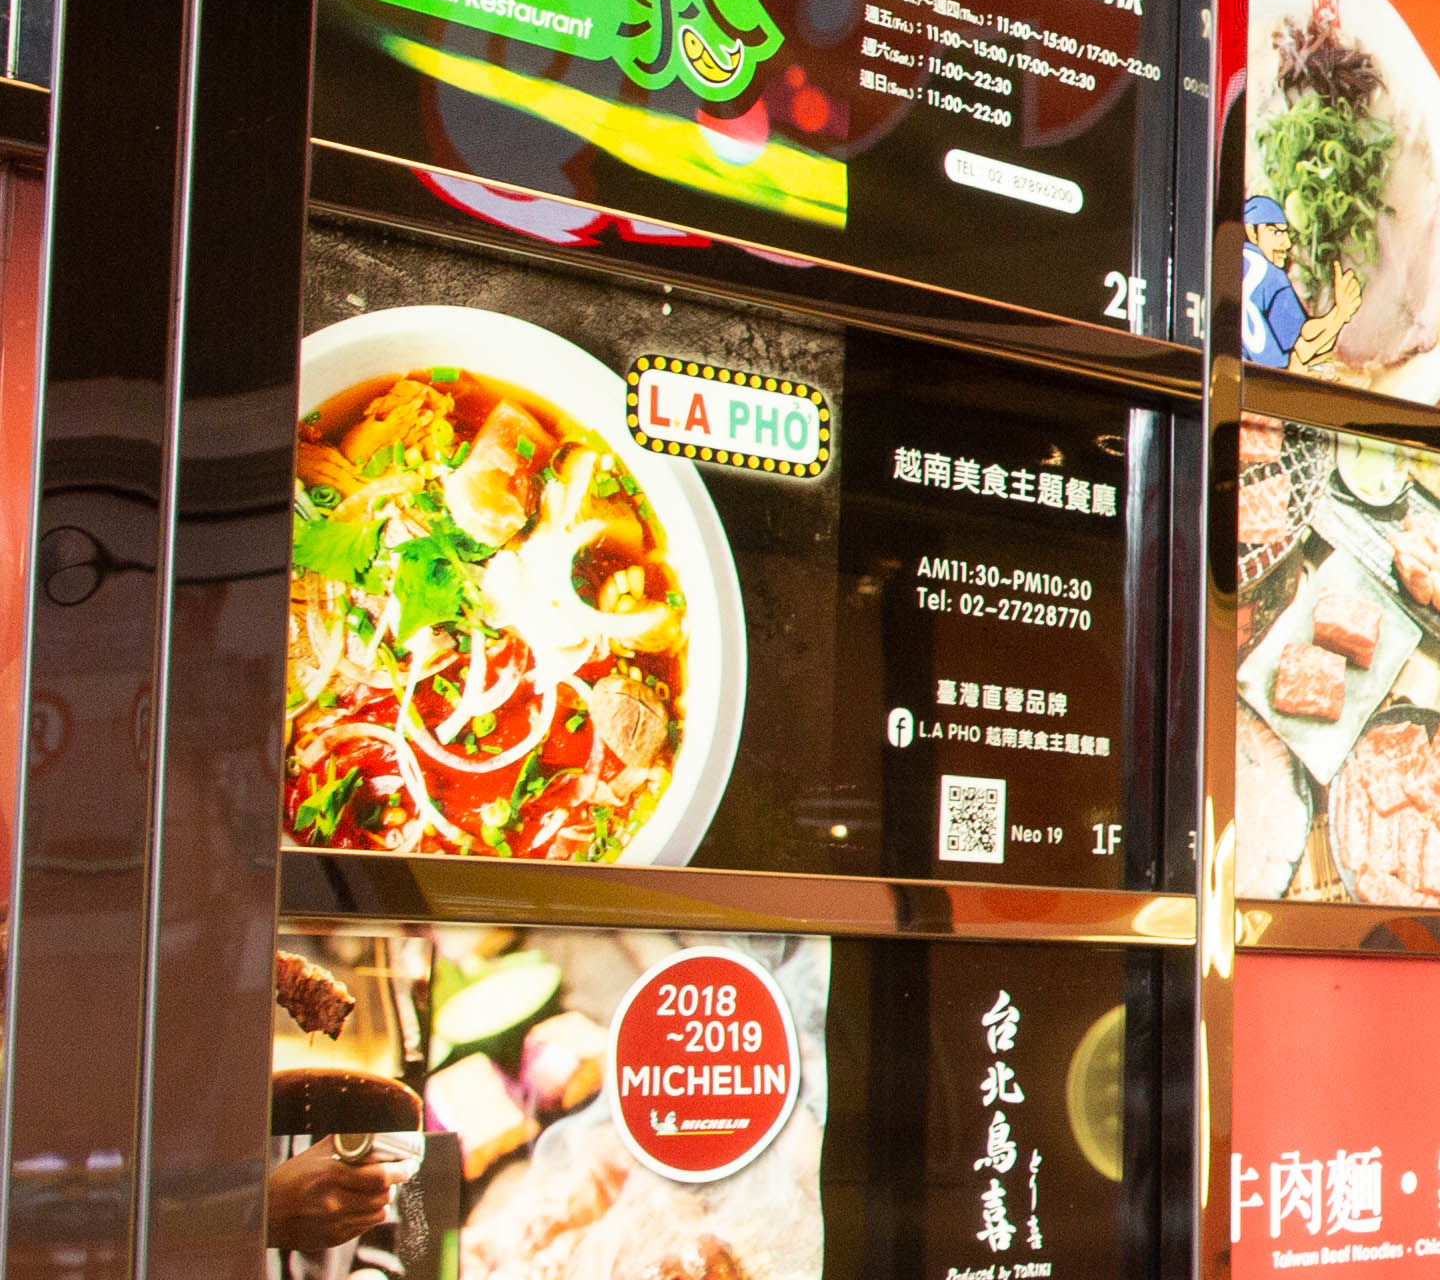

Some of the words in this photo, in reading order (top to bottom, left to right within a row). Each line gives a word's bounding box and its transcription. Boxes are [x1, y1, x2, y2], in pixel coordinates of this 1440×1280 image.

[1104, 272, 1147, 323] 2F
[650, 385, 711, 436] L.A
[893, 447, 1118, 518] 越南美食主題餐廳
[917, 557, 1093, 601] AM11:30~PM10:30
[916, 587, 953, 614] Tel:
[959, 593, 1092, 630] 02-27228770
[937, 679, 1069, 717] 臺灣直營品牌
[919, 721, 944, 740] L.A
[948, 724, 981, 743] PHO
[985, 726, 1111, 757] 越南美食主題餐廳
[1011, 824, 1043, 844] Neo
[1046, 825, 1063, 845] 19
[1092, 824, 1122, 856] 1F
[657, 984, 737, 1017] 2018
[666, 1020, 762, 1053] ~2019
[621, 1064, 786, 1096] MICHELIN
[681, 1118, 749, 1130] MICHELIN
[974, 990, 1025, 1253] 台北鳥喜
[1273, 1249, 1319, 1269] Taiwan
[1321, 1245, 1351, 1265] Beef
[1352, 1241, 1403, 1262] Noodles
